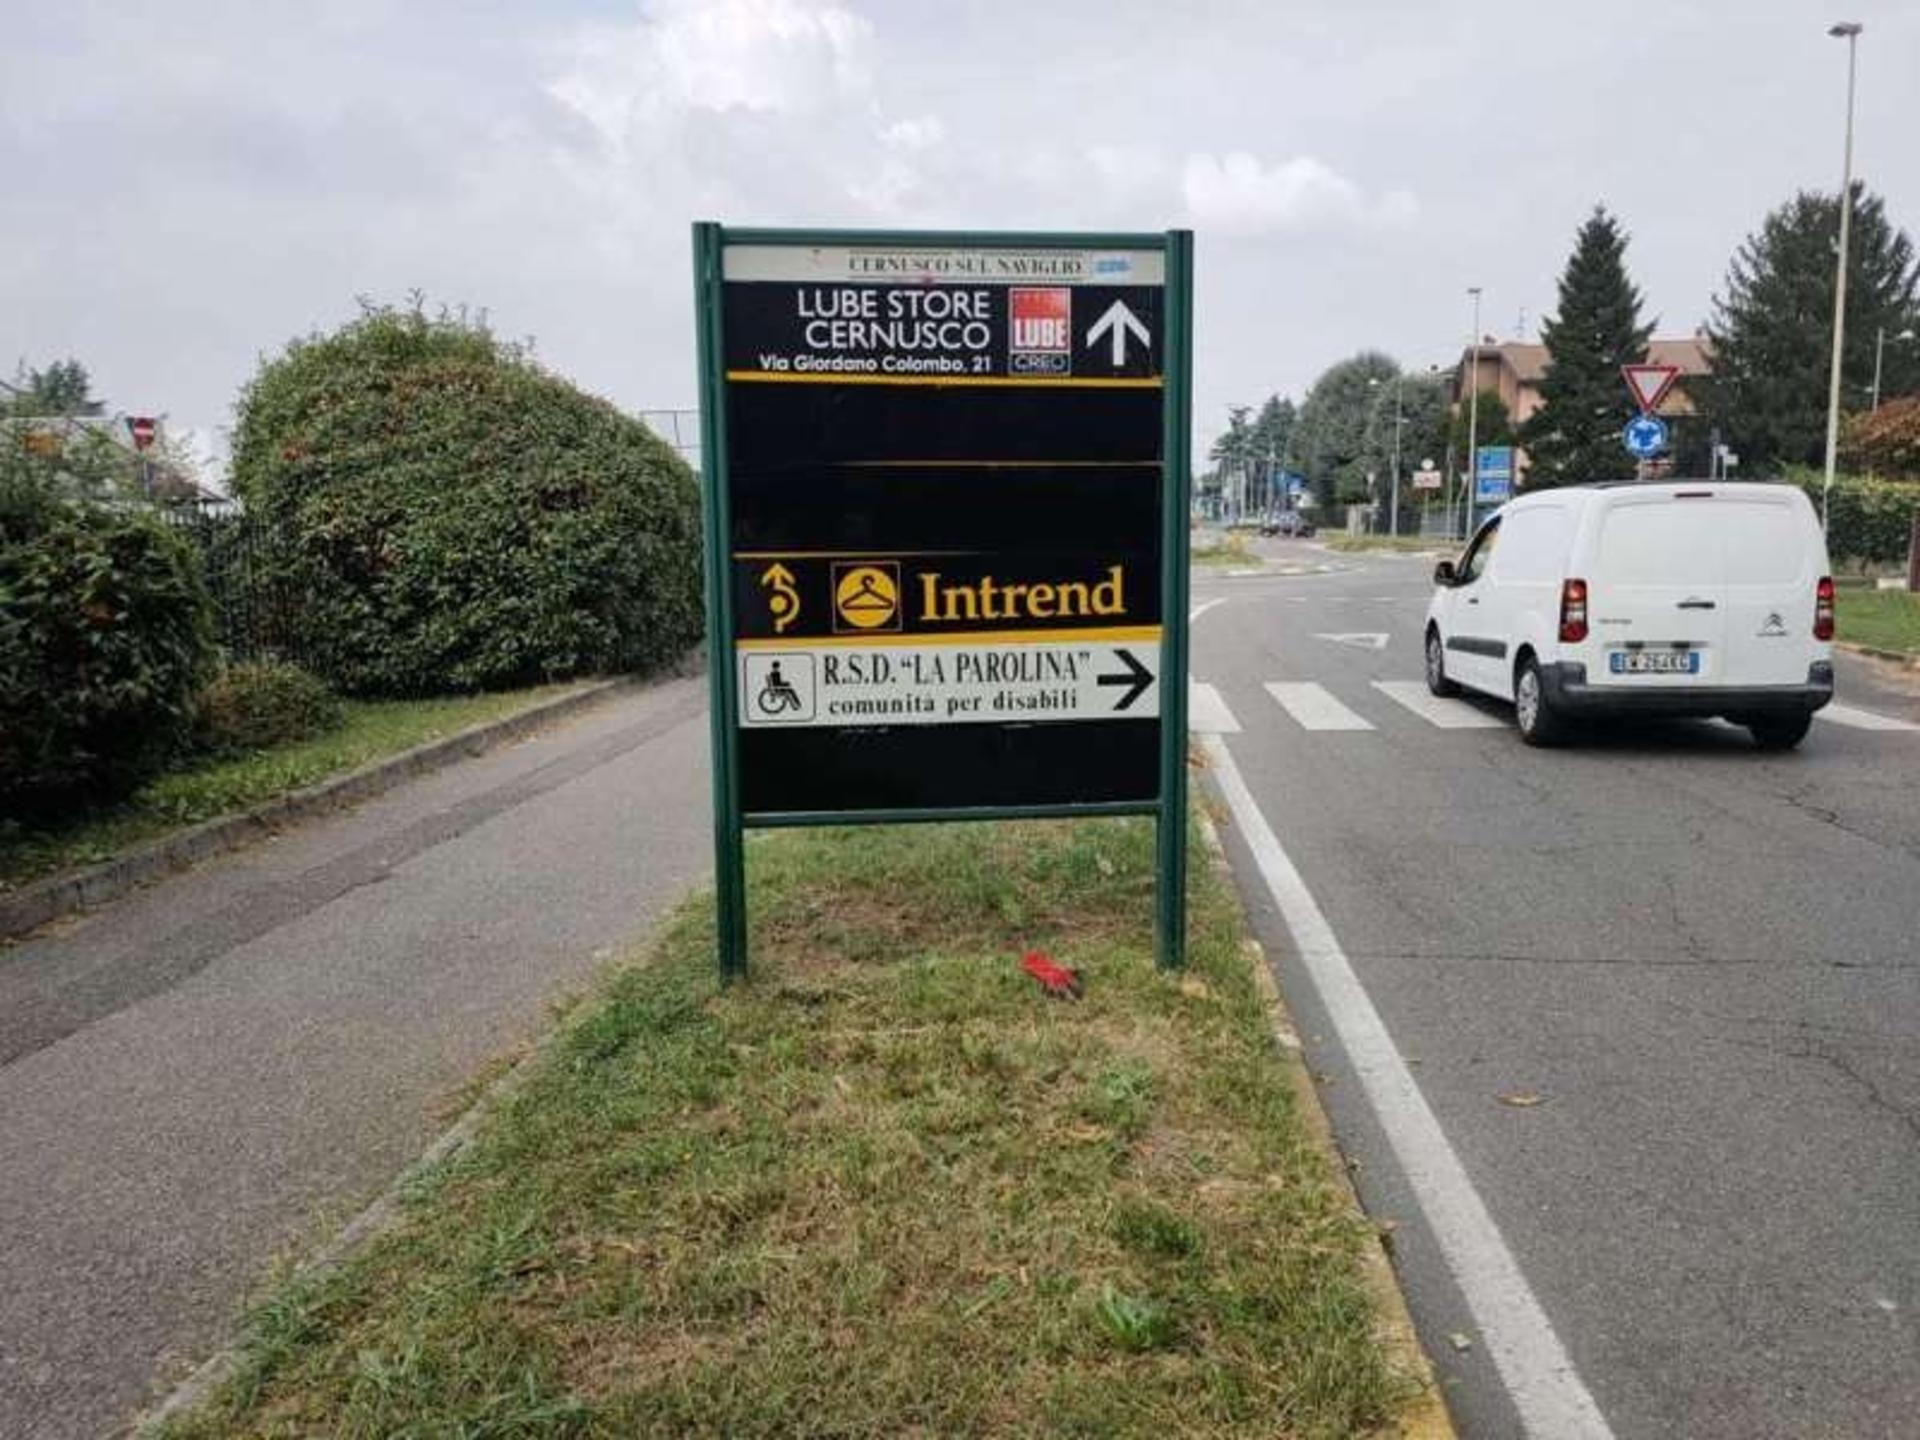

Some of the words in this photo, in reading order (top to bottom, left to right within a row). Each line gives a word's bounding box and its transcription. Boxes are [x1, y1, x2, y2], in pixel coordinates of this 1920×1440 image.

[848, 256, 950, 273] CERNUSCO
[955, 256, 991, 274] SUL
[998, 257, 1082, 275] NAVIGLIO
[798, 289, 879, 318] LUBE
[887, 290, 991, 319] STORE
[805, 321, 991, 350] CERNUSCO
[1014, 318, 1067, 348] LUBE
[759, 355, 788, 370] Via
[794, 355, 877, 372] Giordano
[972, 355, 990, 372] 21
[918, 565, 1126, 620] Intrend
[824, 653, 896, 685] R.S.D.
[947, 694, 982, 716] per
[993, 688, 1077, 711] disabili
